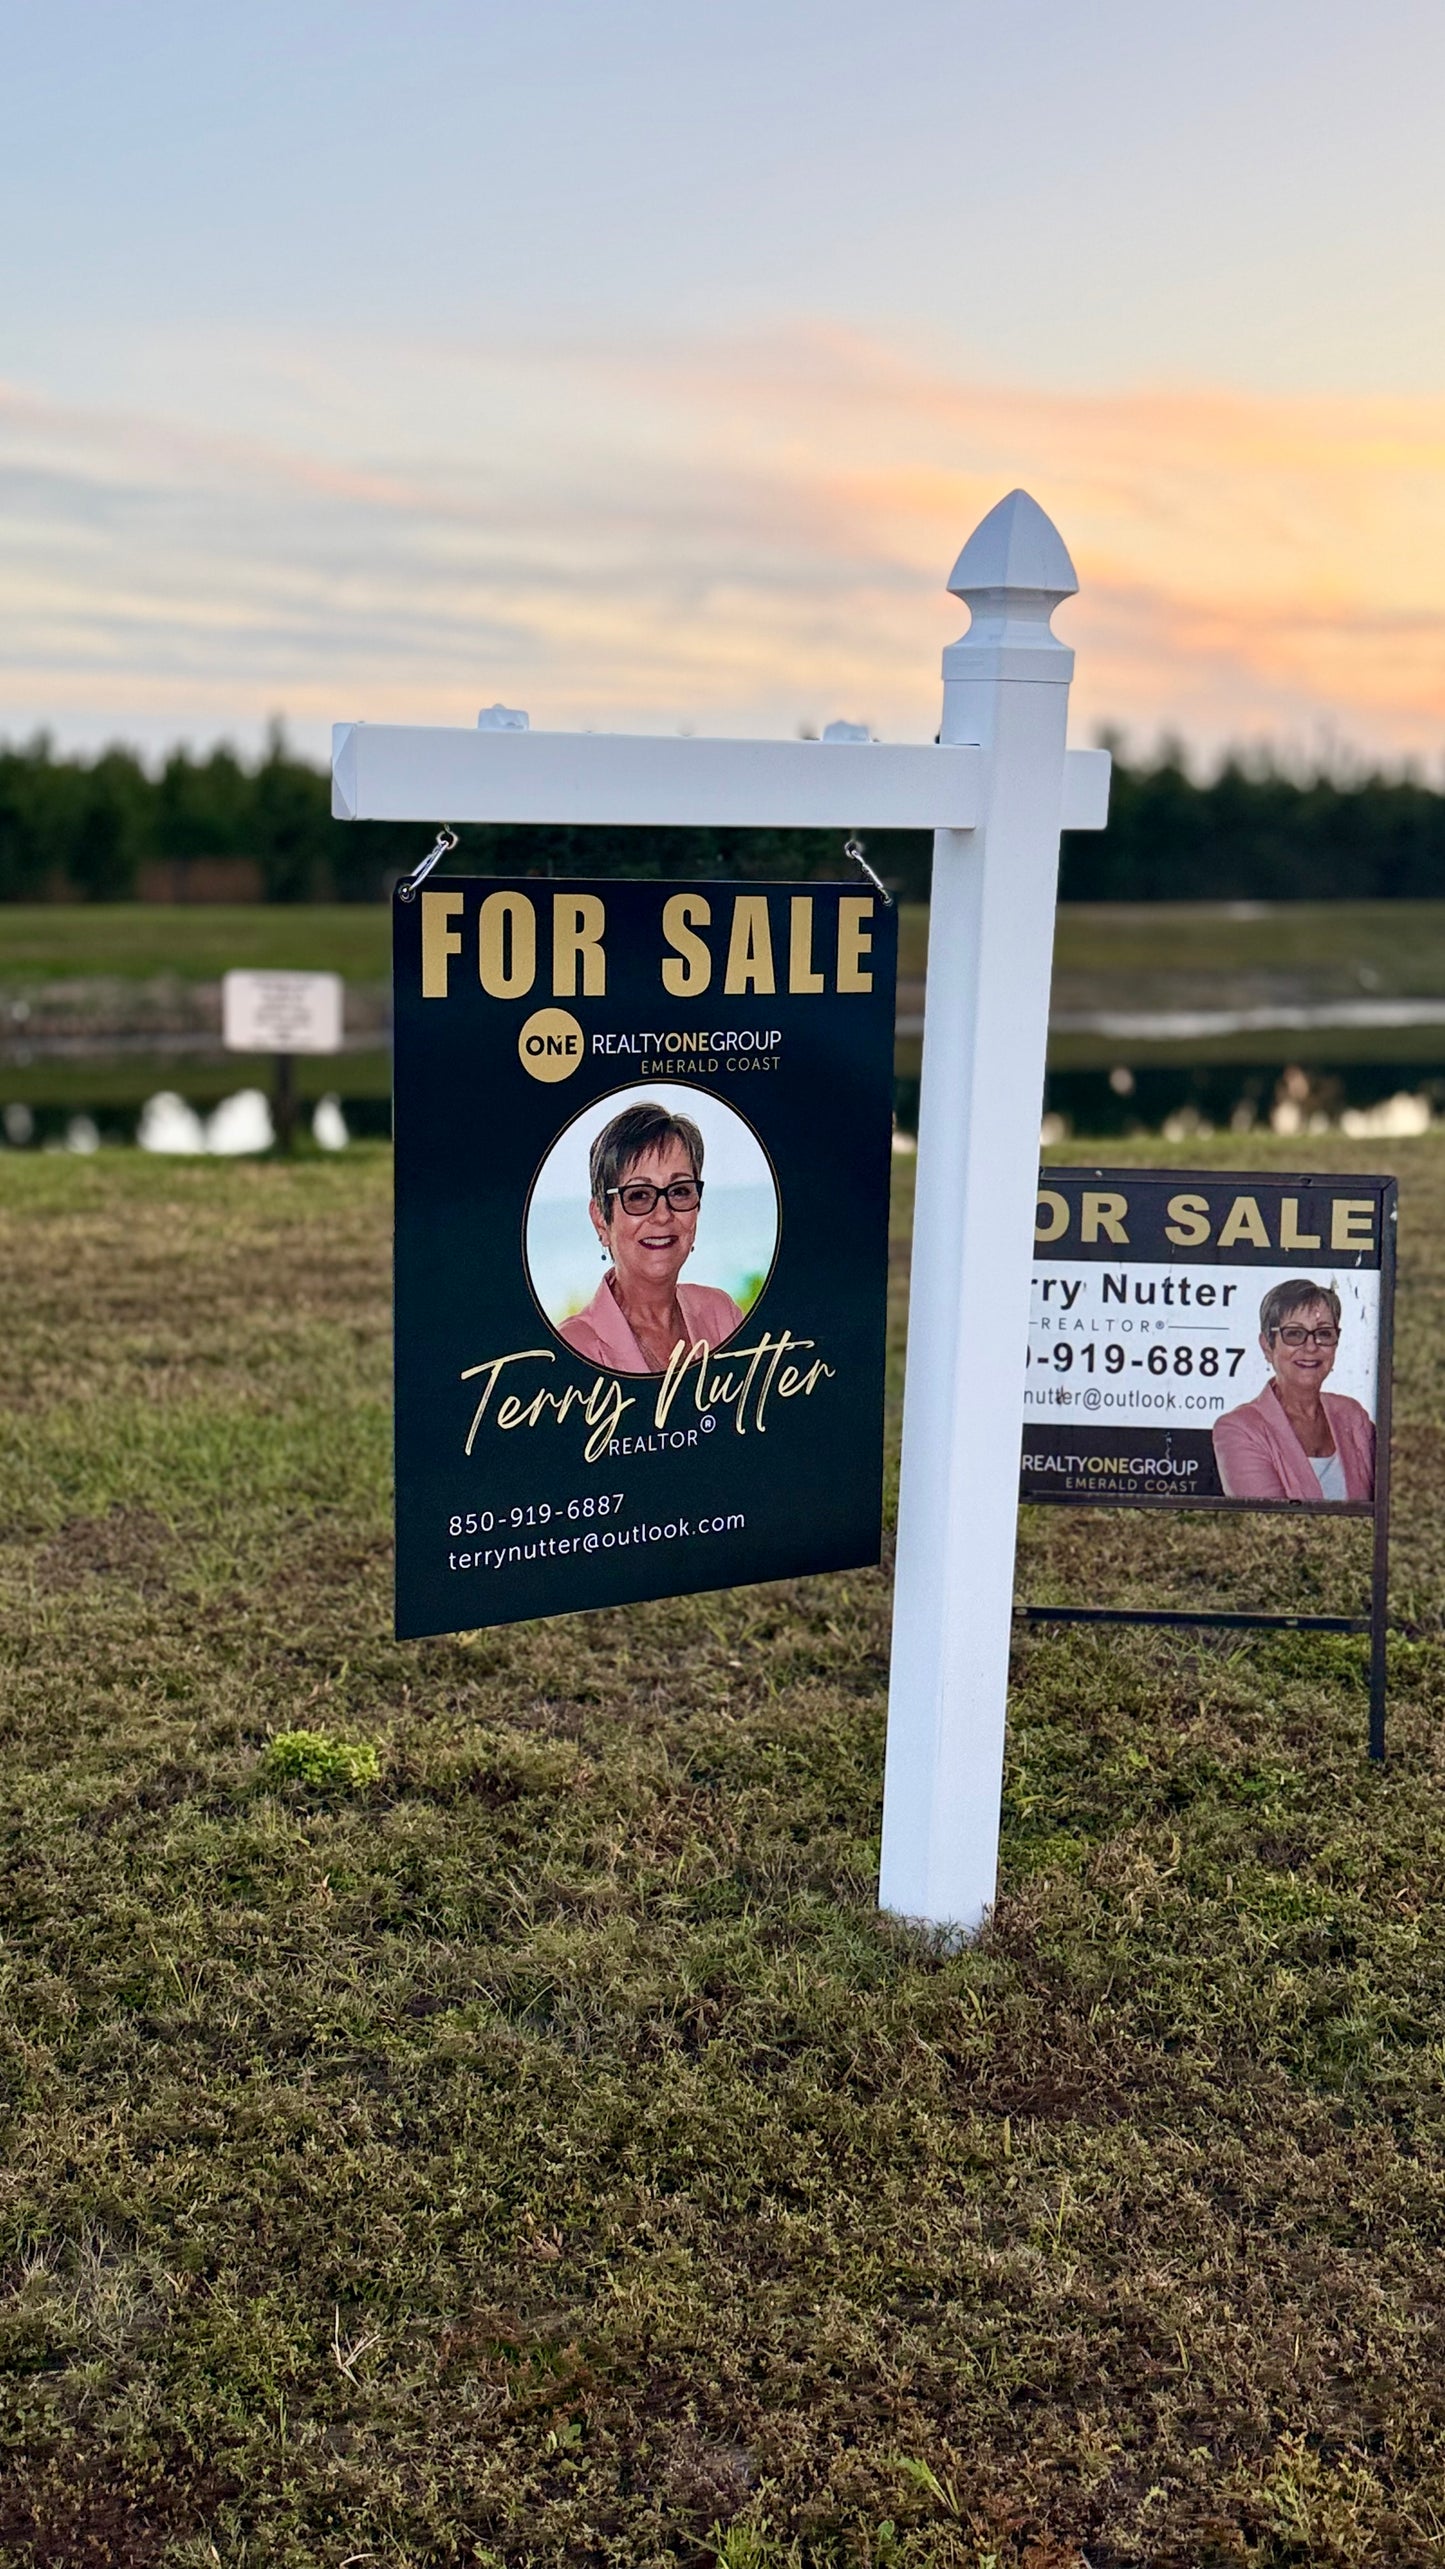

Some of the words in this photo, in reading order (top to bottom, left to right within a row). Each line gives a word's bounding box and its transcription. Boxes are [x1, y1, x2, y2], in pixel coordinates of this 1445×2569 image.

[421, 890, 606, 999] FOR
[662, 893, 875, 997] SALE
[525, 1034, 578, 1057] ONE
[592, 1030, 782, 1055] REALTYONEGROUP
[641, 1057, 719, 1075] EMERALD
[726, 1056, 781, 1072] COAST
[1034, 1189, 1130, 1244] OR
[1164, 1194, 1376, 1251] SALE
[1102, 1273, 1238, 1308] Nutter
[1026, 1342, 1247, 1378] -919-6887
[460, 1349, 637, 1463] Terry
[654, 1330, 836, 1435] Nutter
[1023, 1386, 1226, 1412] nutter@outlook.com
[1021, 1455, 1199, 1476] REALTYONEGROUP
[1065, 1477, 1138, 1492] EMERALD
[1144, 1479, 1198, 1493] COAST
[448, 1493, 625, 1537] 850-919-6887
[448, 1512, 746, 1571] terrynutter@outlook.com
